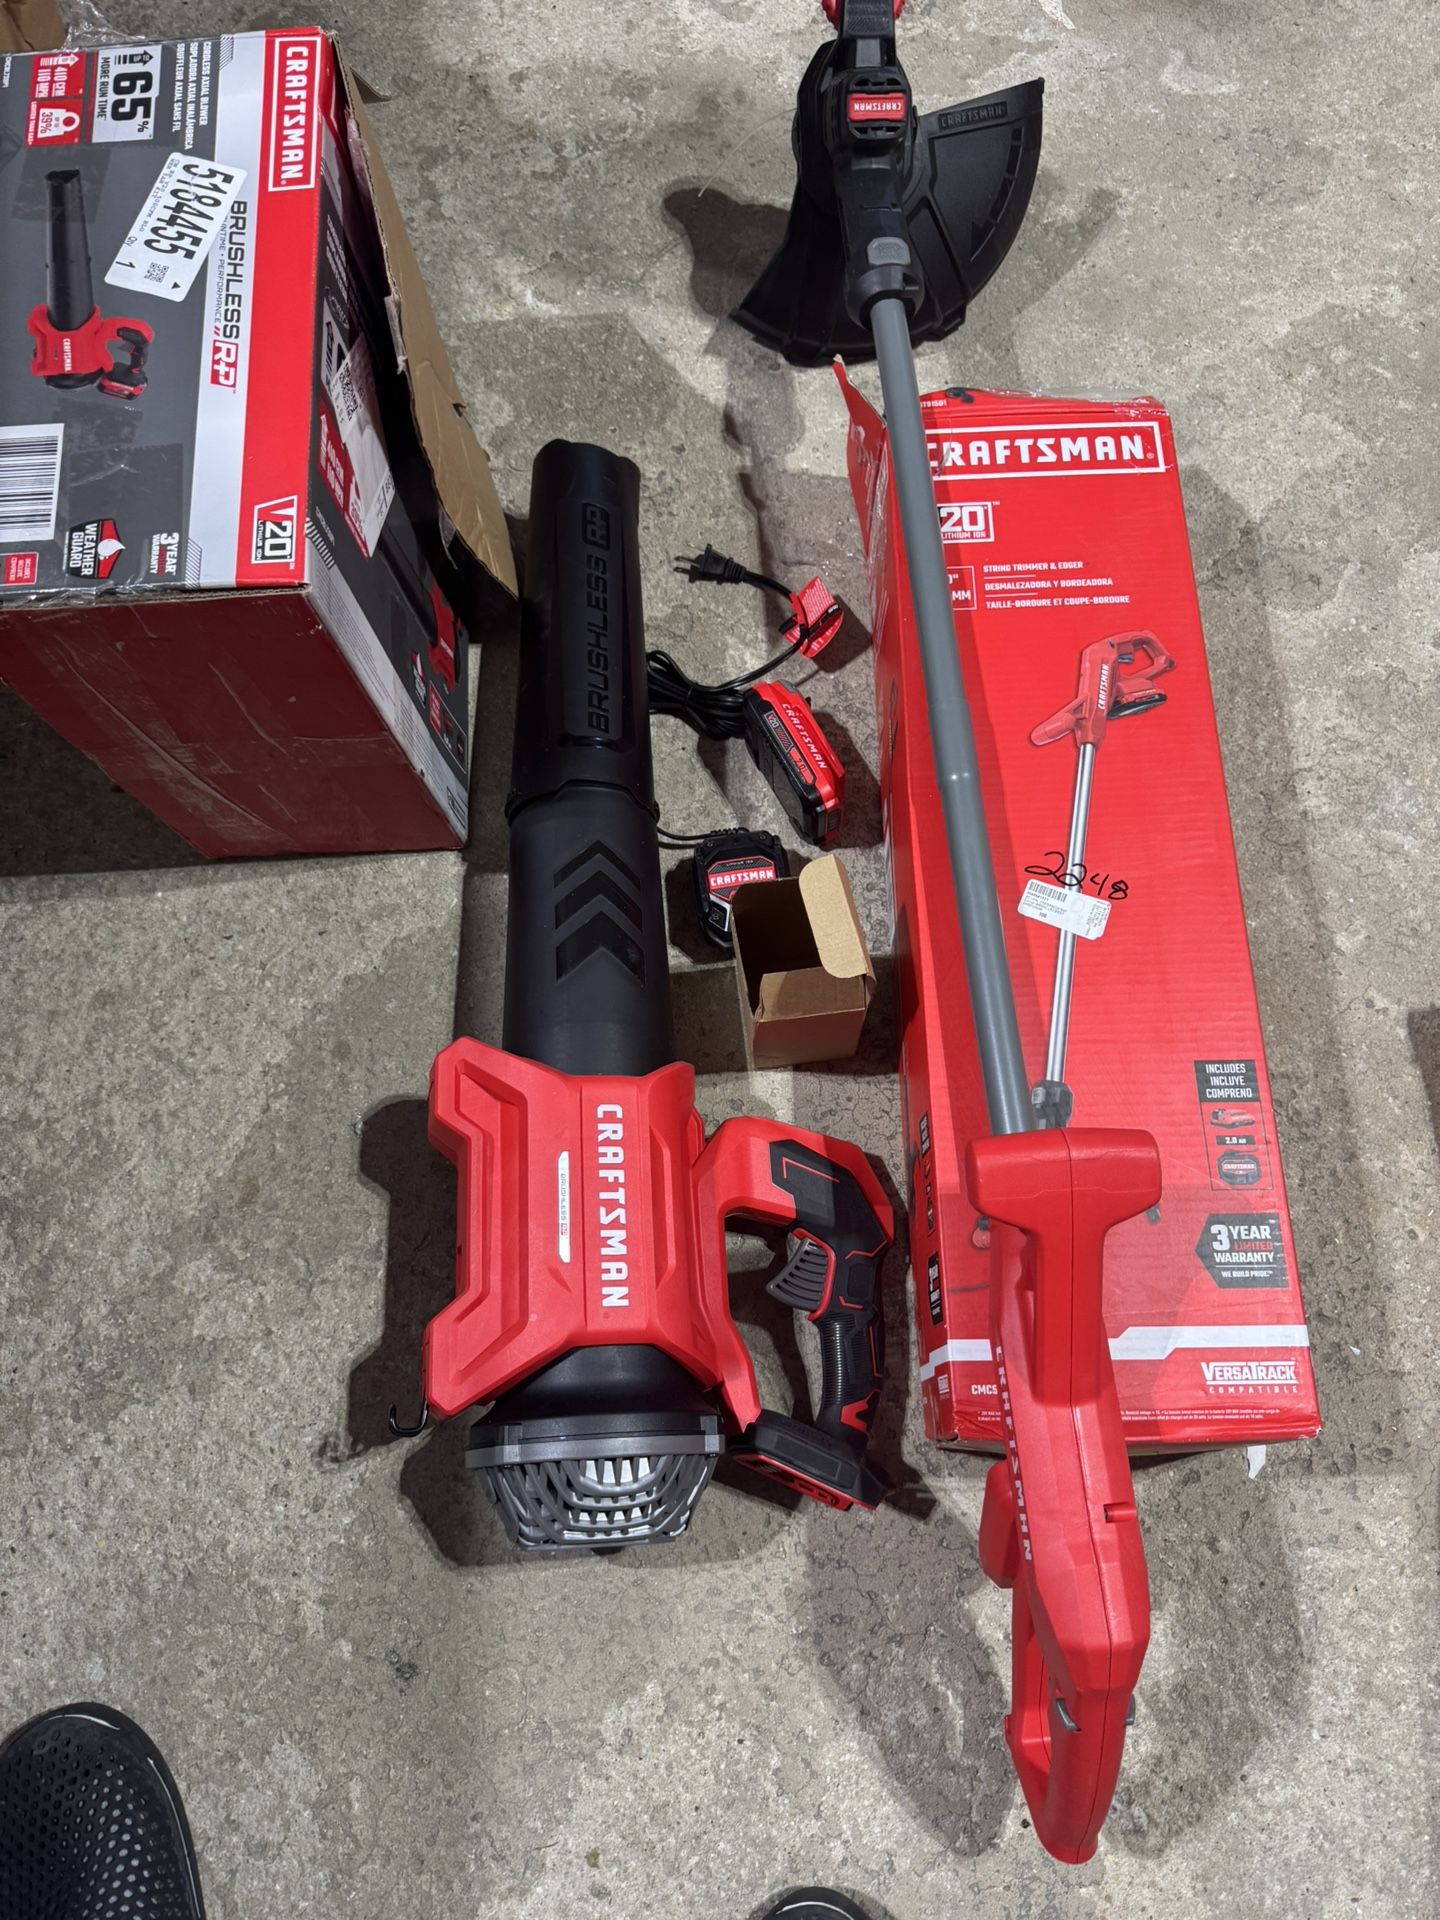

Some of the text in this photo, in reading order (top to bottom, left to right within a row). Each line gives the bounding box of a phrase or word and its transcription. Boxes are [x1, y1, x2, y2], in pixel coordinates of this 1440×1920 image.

[37, 69, 51, 98] 110 MPH
[54, 67, 67, 81] 410
[172, 43, 185, 132] SOUFFLEUR AXIAL SANS FIL
[198, 41, 212, 126] CORDLESS AXIAL BLOWER
[97, 57, 111, 119] MORE RUN TIME
[184, 42, 199, 150] SOPLADORA AXIAL INALÁMBRICA
[280, 46, 309, 182] CRAFTSMAN
[854, 101, 901, 111] CRAFTSMAN
[941, 106, 1003, 126] CRAFTSMAN
[40, 112, 53, 134] 39%
[144, 164, 234, 260] 5184455
[124, 236, 137, 247] Qty
[223, 201, 247, 339] BRUSHLESS
[214, 259, 226, 323] PERFORMANCE
[62, 338, 73, 373] CRAFTSMAN
[938, 505, 986, 532] 20
[941, 530, 986, 541] LITHIUM ION
[69, 532, 85, 568] GUARD
[80, 523, 98, 576] WEATHER
[150, 534, 160, 574] WARRANTY
[160, 532, 180, 573] 3 YEAR
[983, 561, 1083, 573] STRING TRIMMER & EDGER
[951, 589, 971, 601] MM
[984, 578, 1113, 591] DESMALEZADORA Y BORDEADORA
[986, 595, 1130, 609] TAILLE-BORDURE ET COUPE-BORDURE
[587, 553, 609, 733] BRUSHLESS
[1097, 664, 1109, 709] CRAFTSMAN
[766, 713, 780, 728] V20
[782, 703, 828, 769] CRAFTSMAN
[710, 870, 774, 887] CRAFTSMAN
[1024, 851, 1129, 900] 2248
[1205, 1064, 1246, 1074] INCLUDES
[1210, 1076, 1245, 1086] INCLUYE
[1206, 1088, 1252, 1098] COMPREND
[560, 1173, 568, 1221] BRUSHLESS
[597, 1104, 630, 1307] CRAFTSMAN
[1210, 1224, 1272, 1250] 3 YEAR
[1233, 1241, 1273, 1251] LIMITED
[1214, 1252, 1274, 1263] WARRANTY
[1221, 1270, 1232, 1278] WE
[1233, 1270, 1249, 1278] BUILD
[971, 1384, 998, 1395] CMCS
[1209, 1385, 1298, 1394] COMPATIBLE
[996, 1346, 1032, 1560] CRAFTSMAN
